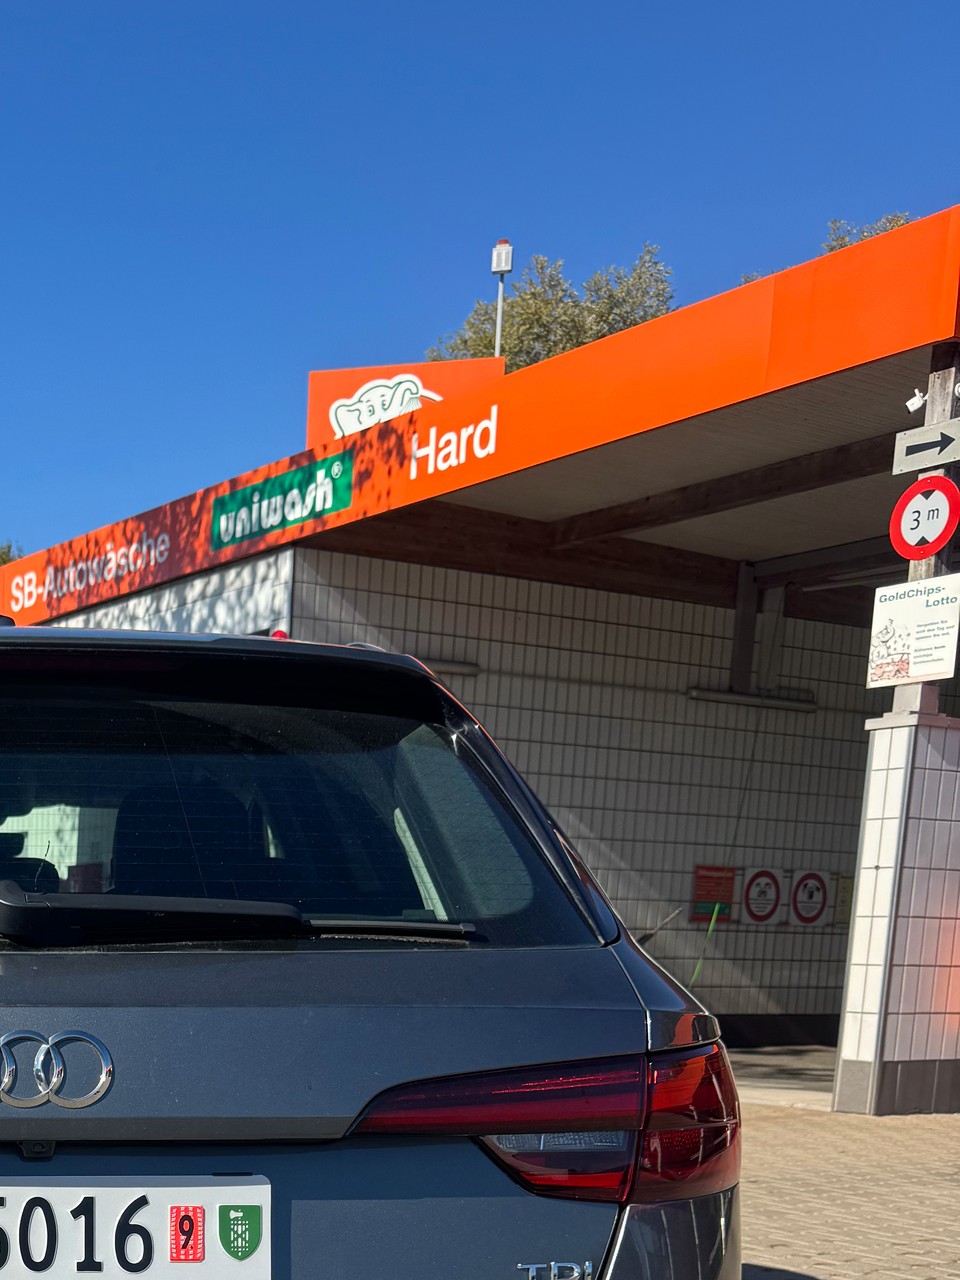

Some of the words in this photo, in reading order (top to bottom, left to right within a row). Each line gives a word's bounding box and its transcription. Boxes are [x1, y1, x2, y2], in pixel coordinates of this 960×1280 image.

[410, 404, 499, 481] Hard
[909, 509, 921, 531] 3
[926, 507, 940, 521] m
[10, 531, 171, 613] SB-Autowäsche
[878, 586, 946, 604] GoldChips-
[925, 596, 958, 608] Lotto
